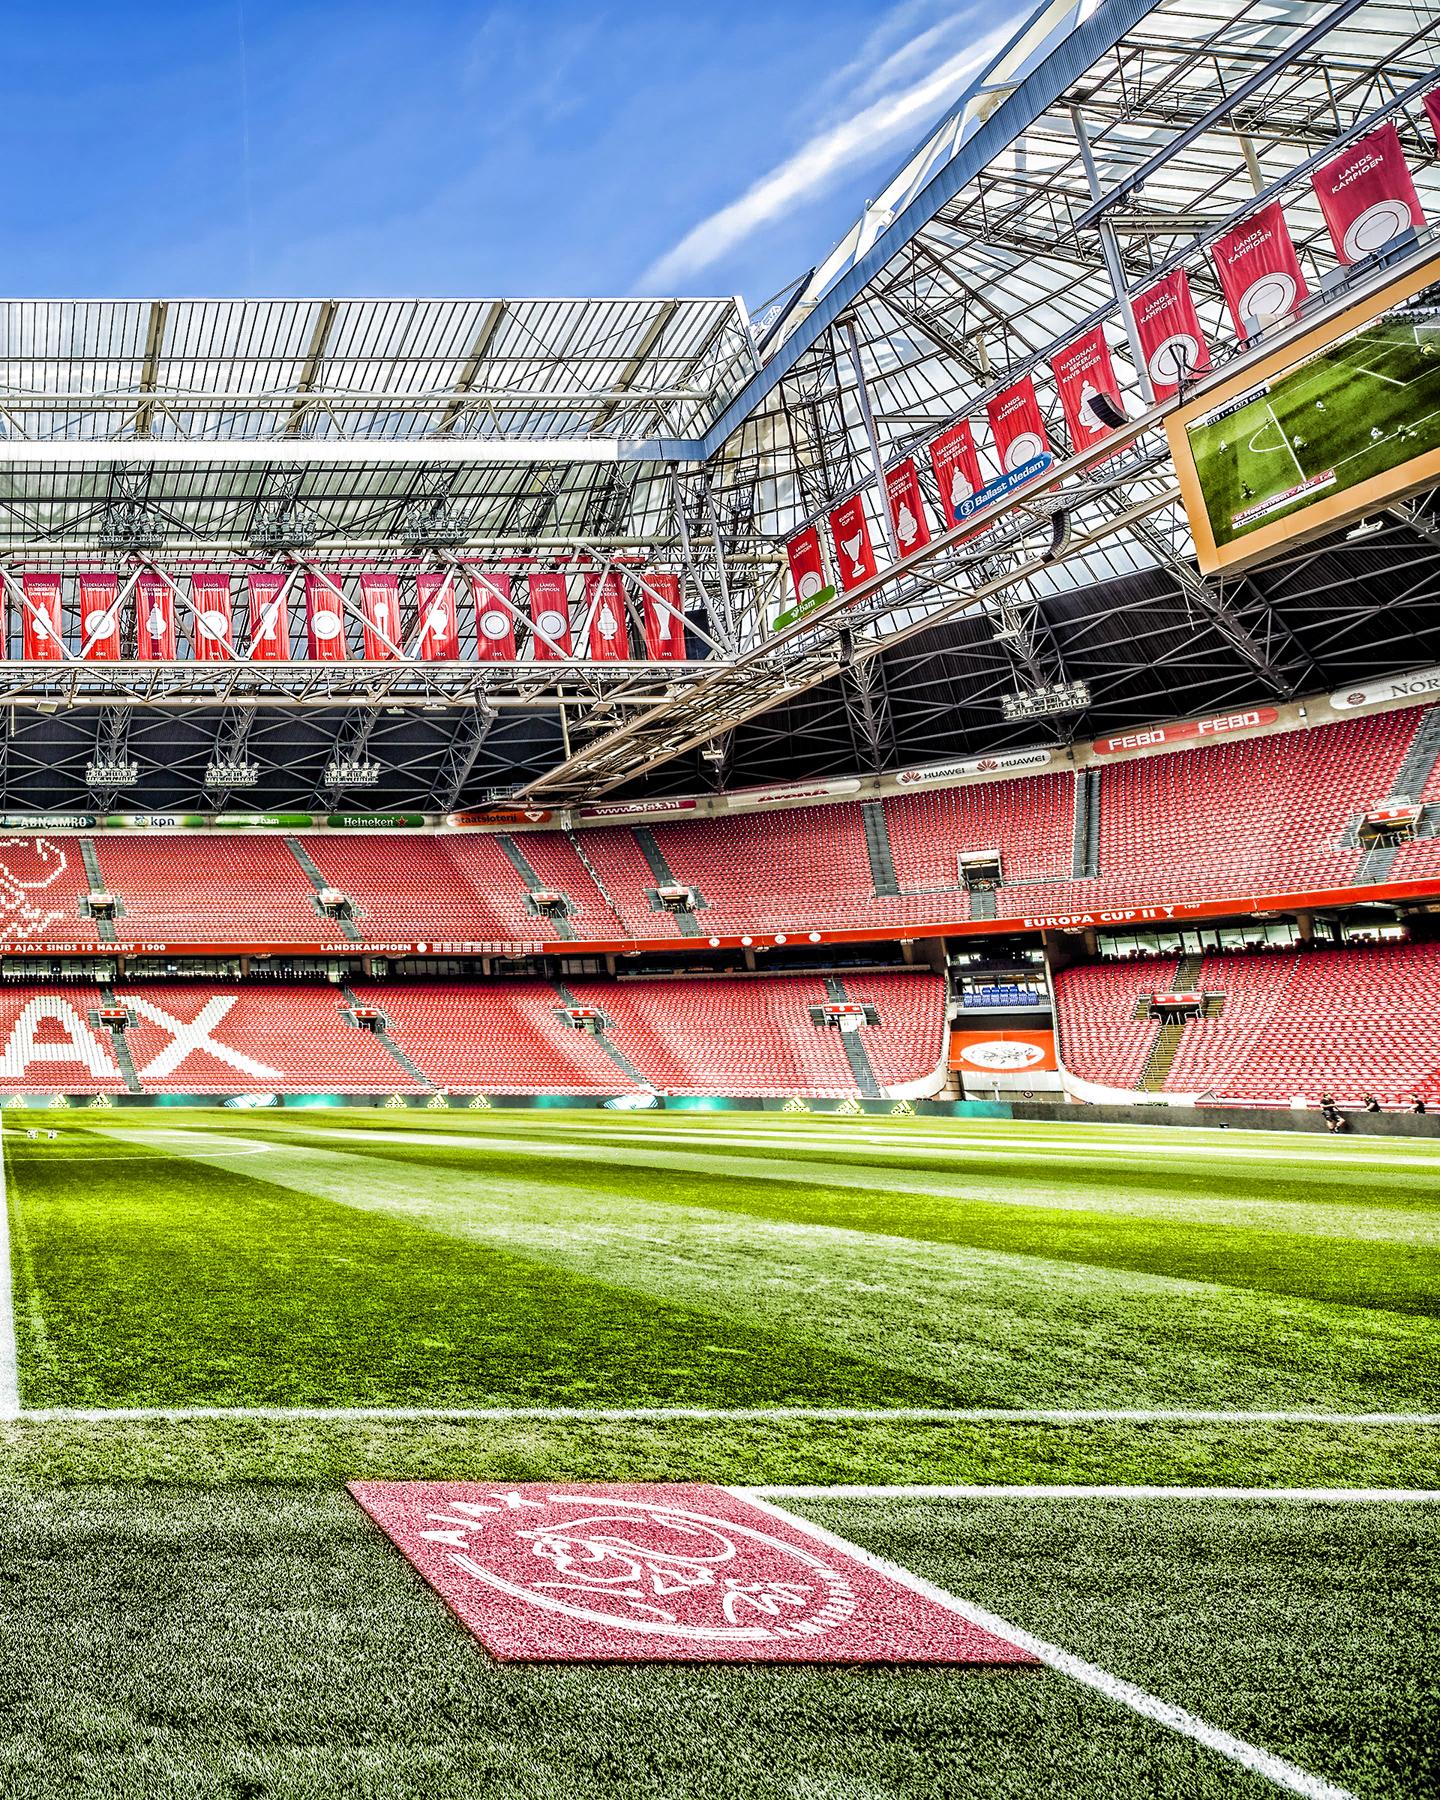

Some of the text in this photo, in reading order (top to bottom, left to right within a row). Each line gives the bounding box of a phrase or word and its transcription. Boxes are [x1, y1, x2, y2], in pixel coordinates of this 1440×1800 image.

[1332, 155, 1384, 194] KAMPIOEN
[1338, 154, 1373, 180] LANDS
[1228, 231, 1272, 265] KAMPIOEN
[1233, 229, 1262, 252] LANDS
[1139, 295, 1178, 324] KAMPIOEN
[1145, 293, 1170, 313] LANDS
[1060, 343, 1097, 371] NATIONALE
[1082, 356, 1102, 374] BEKER
[1000, 396, 1021, 412] LANDS
[975, 460, 1045, 507] Ballast Nedam
[1296, 479, 1316, 493] Ajax
[800, 600, 815, 617] bam
[1108, 712, 1259, 750] FEBO FEBO
[924, 755, 1045, 779] HUAWEI HUAWEI
[151, 816, 175, 827] kpn
[344, 817, 393, 827] Heineken
[1023, 909, 1156, 928] EUROPA CUP II
[418, 1490, 543, 1548] AJAX
